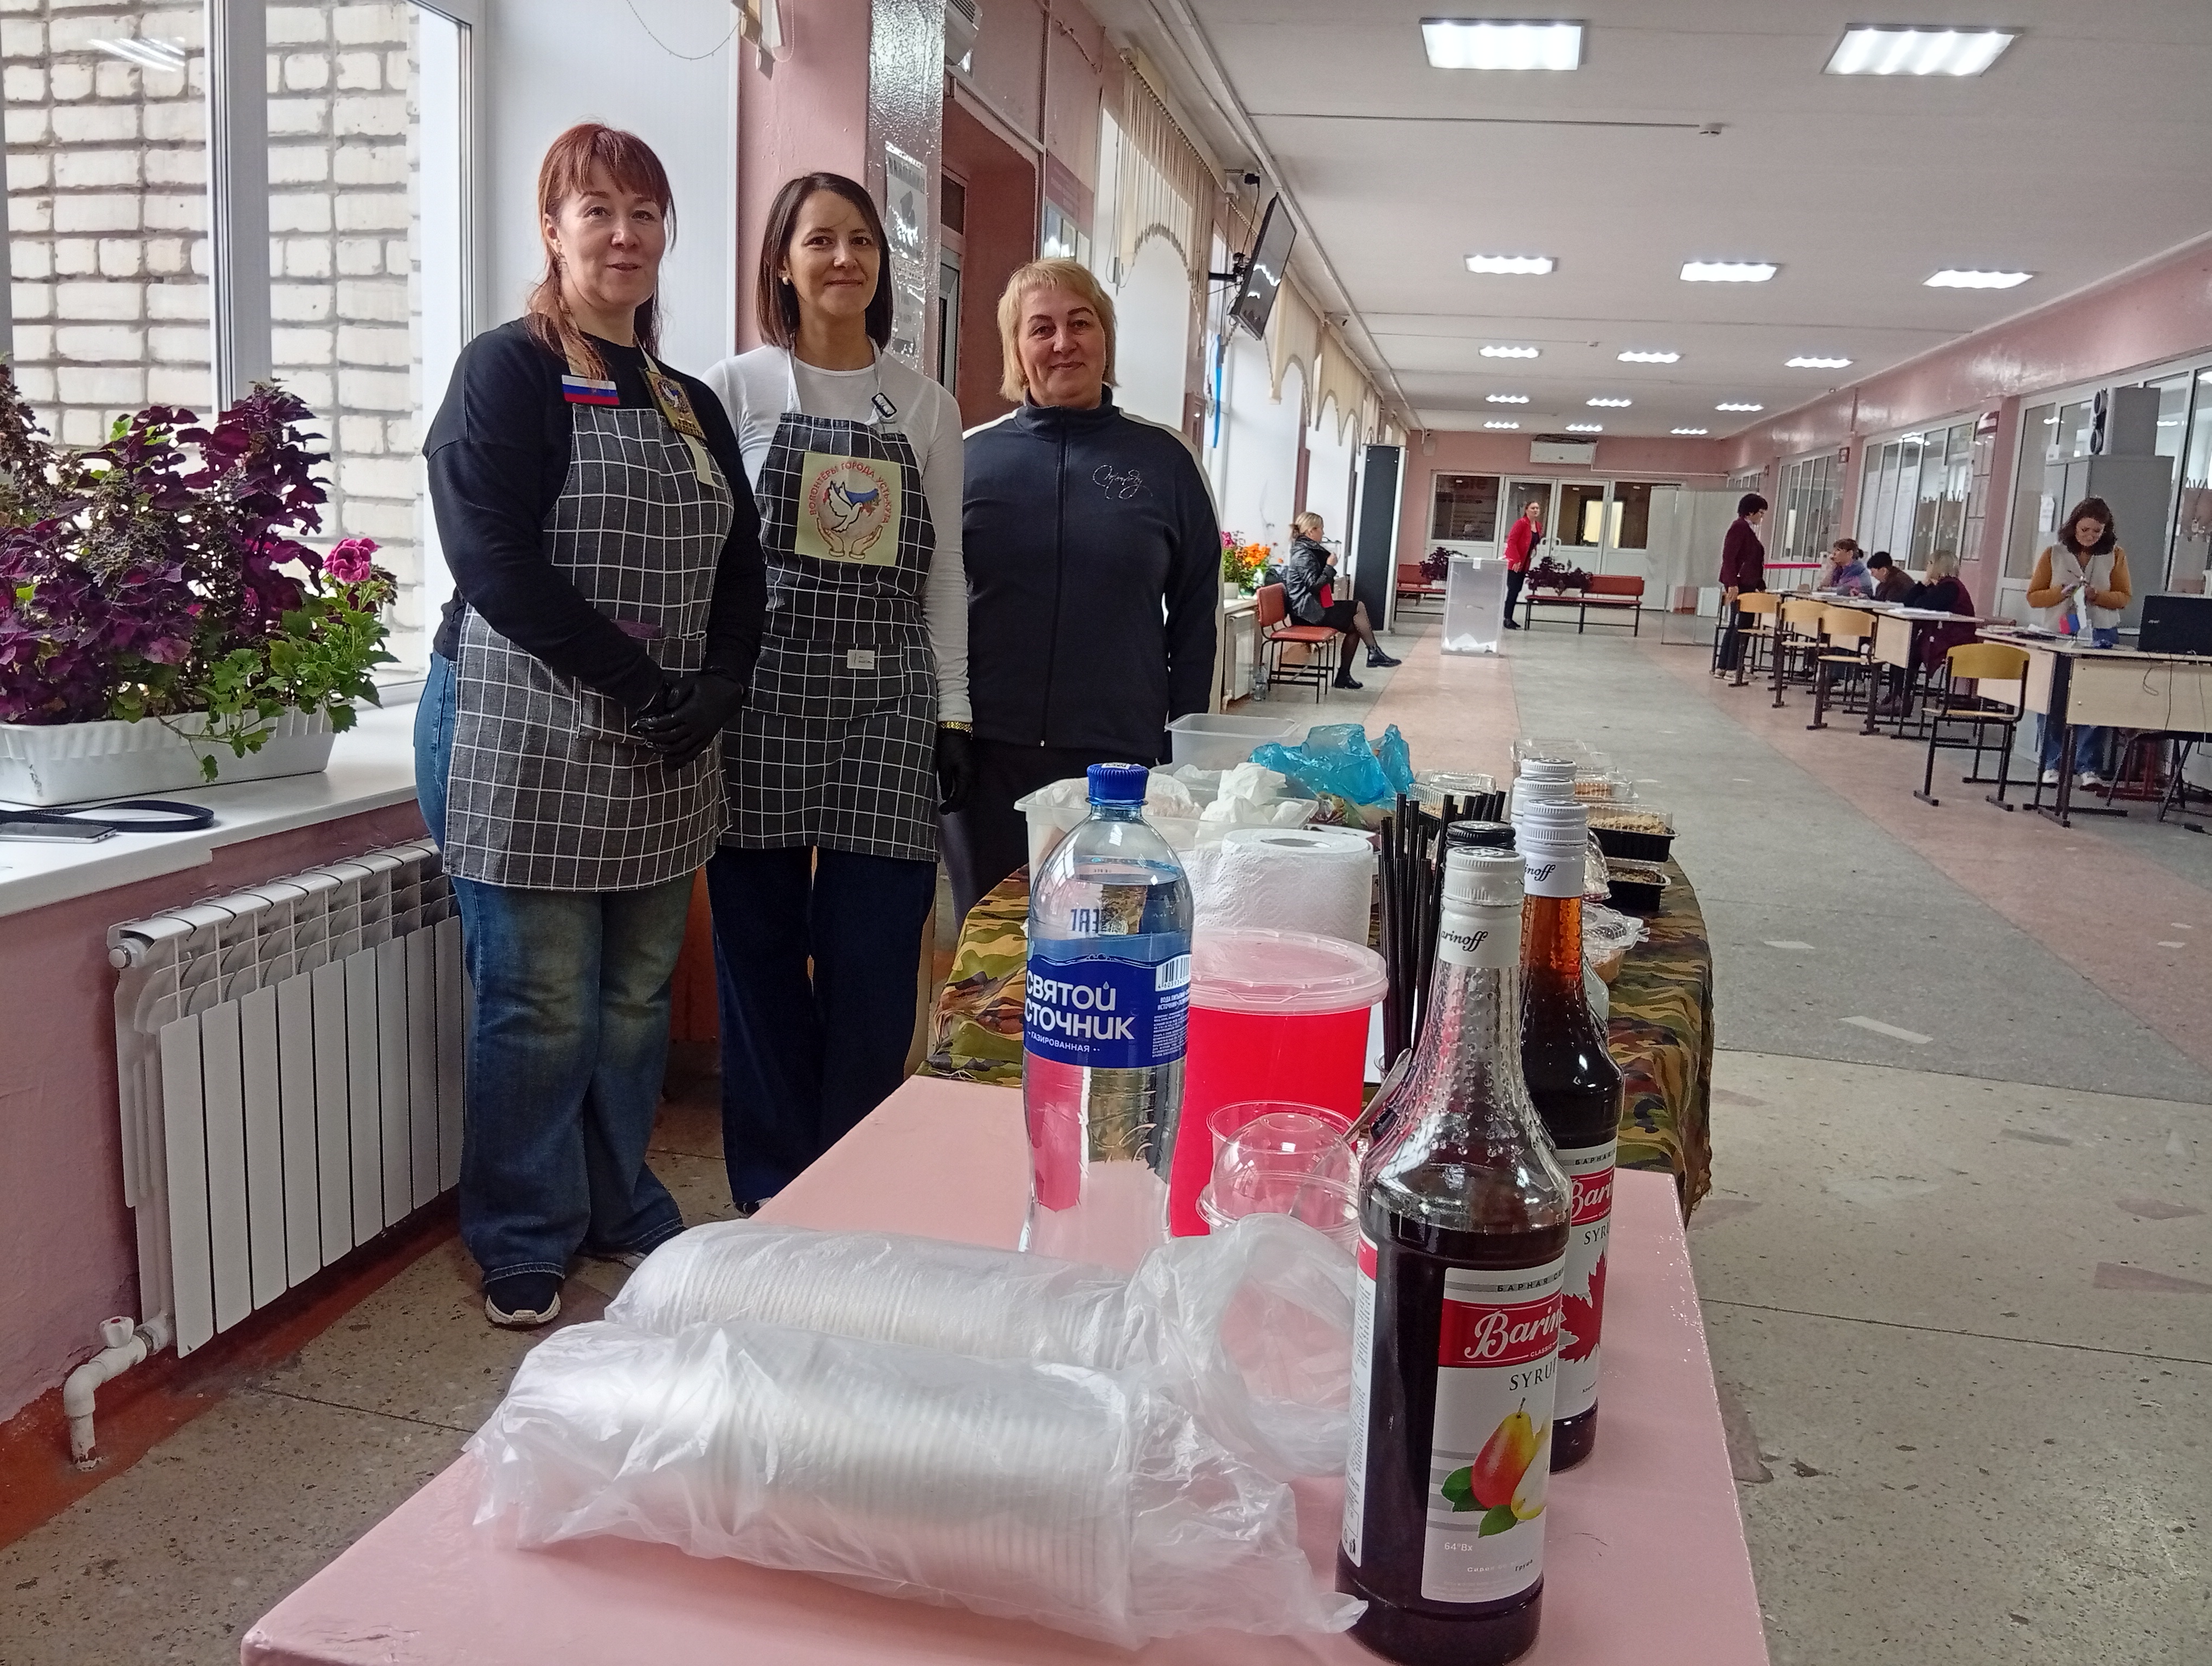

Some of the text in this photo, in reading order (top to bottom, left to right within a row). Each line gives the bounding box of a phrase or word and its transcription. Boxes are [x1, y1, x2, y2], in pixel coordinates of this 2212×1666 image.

[841, 461, 875, 478] ГОРОДА
[1524, 864, 1556, 882] inoff
[1441, 930, 1488, 952] arinoff
[1026, 970, 1116, 1011] СВЯТОЙ
[1025, 998, 1136, 1040] СТОЧНИК
[1031, 1031, 1090, 1053] ГАЗИРОВАННАЯ
[1571, 1177, 1613, 1219] Bari
[1584, 1220, 1610, 1245] SYRU
[1497, 1277, 1548, 1292] БАРНАЯ
[1464, 1306, 1560, 1359] Barin
